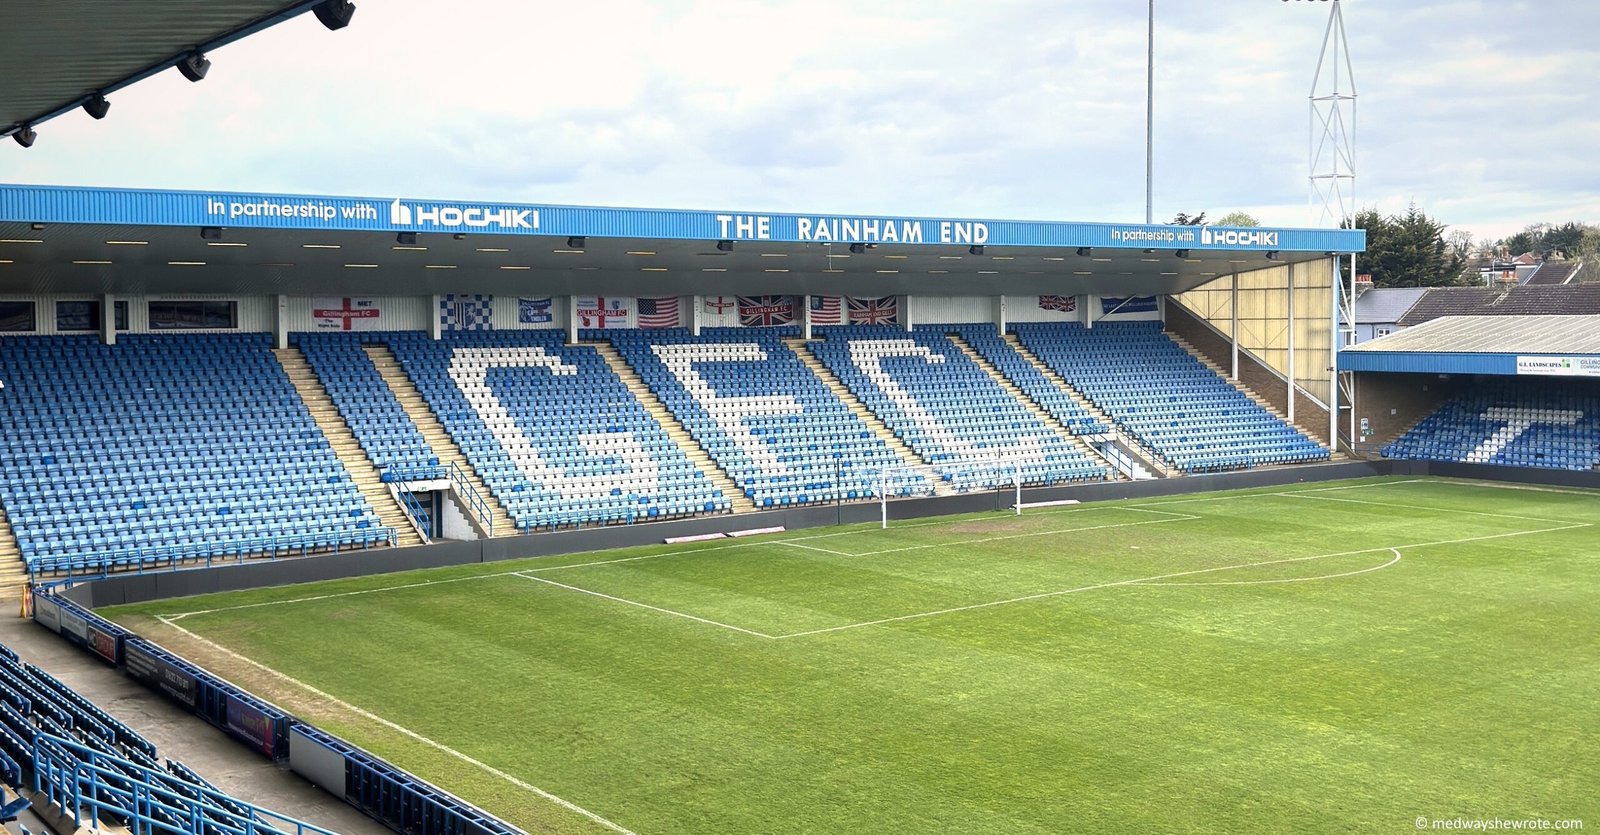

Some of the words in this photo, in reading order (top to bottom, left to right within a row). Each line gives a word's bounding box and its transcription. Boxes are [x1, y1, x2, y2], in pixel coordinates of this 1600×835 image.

[207, 198, 225, 215] In
[230, 200, 337, 221] partnership
[341, 203, 377, 220] with
[416, 206, 539, 229] HOCHIKI
[717, 215, 770, 239] THE
[798, 218, 923, 243] RAINHAM
[941, 222, 989, 243] END
[1111, 228, 1121, 240] In
[1123, 229, 1175, 243] partnership
[1177, 230, 1195, 242] with
[1213, 231, 1279, 246] HOCHIKI
[322, 310, 360, 318] Gillingham
[577, 309, 617, 317] GILLINGHAM
[745, 307, 779, 315] GILLINGHAM
